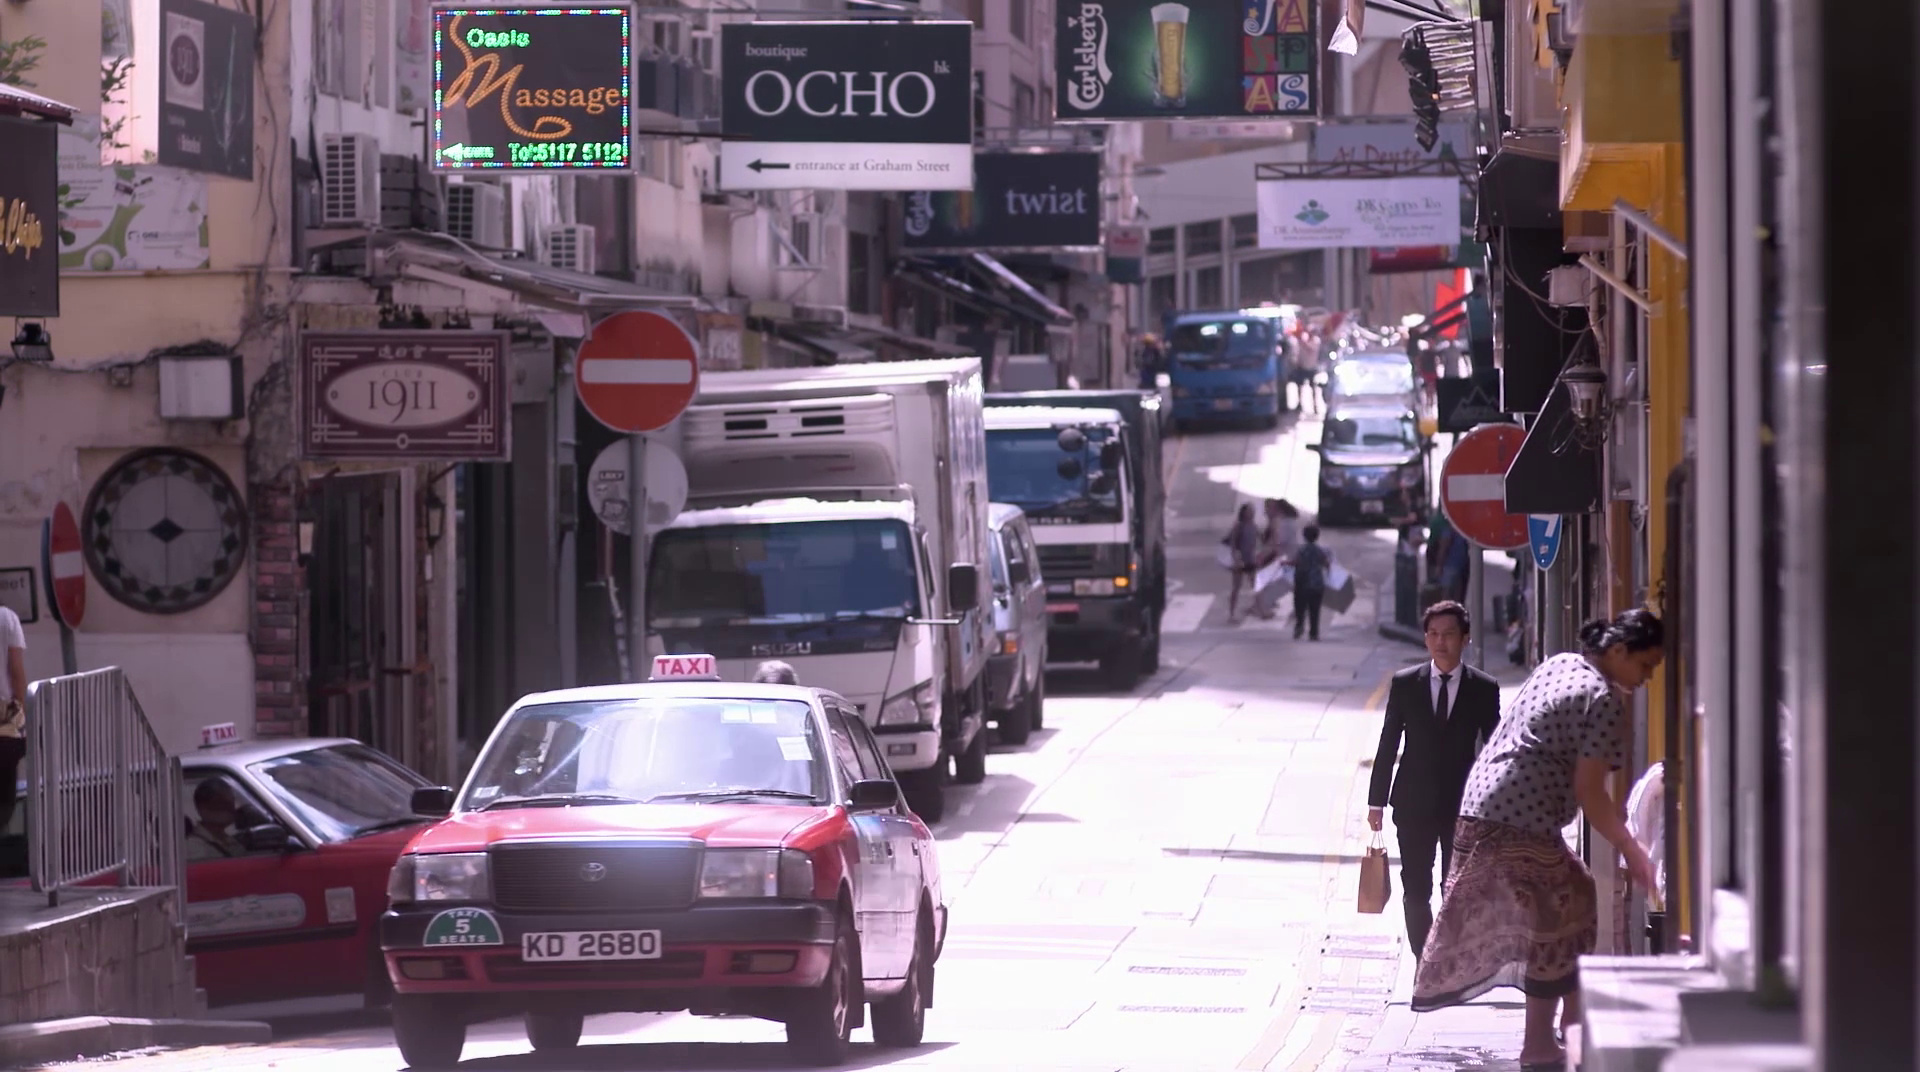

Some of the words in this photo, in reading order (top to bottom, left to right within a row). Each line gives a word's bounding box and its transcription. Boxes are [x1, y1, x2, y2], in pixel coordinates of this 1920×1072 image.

[466, 28, 530, 48] Oasis
[745, 43, 808, 60] boutique
[1067, 3, 1112, 110] Carlsberg
[443, 15, 620, 139] Massage
[744, 69, 936, 118] OCHO
[934, 60, 951, 74] hk
[582, 143, 622, 161] 5112
[795, 160, 845, 172] entrance
[849, 160, 860, 172] at
[864, 158, 913, 172] Graham
[917, 158, 950, 172] Street
[1006, 184, 1087, 215] twist
[368, 379, 439, 424] 1911
[751, 641, 812, 657] ISUZU
[657, 658, 709, 675] TAXI
[213, 726, 237, 741] TAXI
[455, 918, 471, 934] 5
[440, 934, 486, 944] SEATS
[527, 934, 565, 958] KD
[578, 932, 656, 957] 2680
